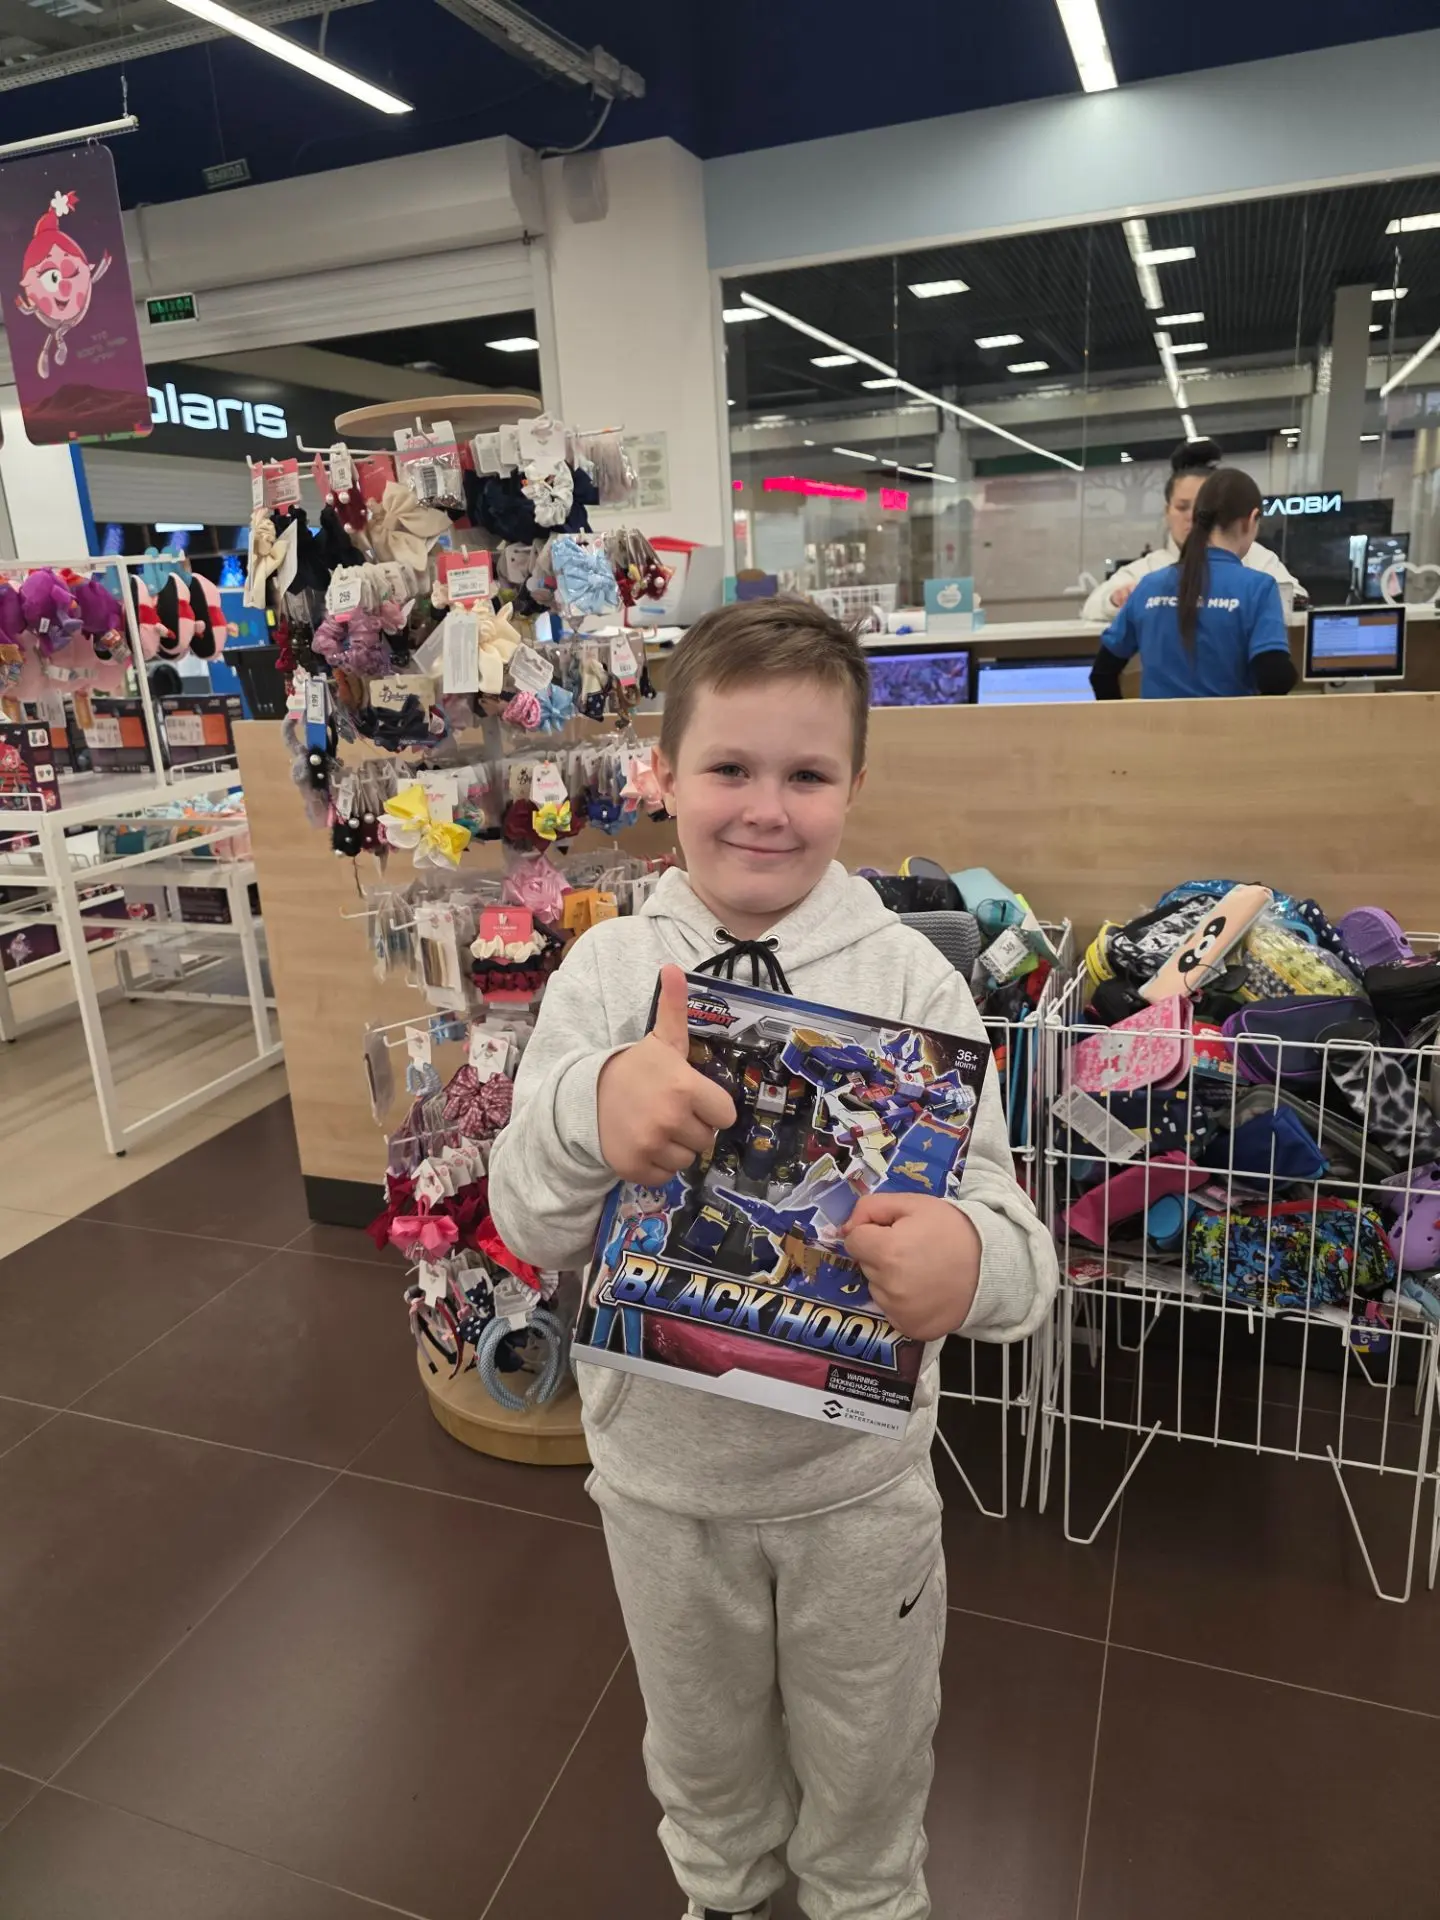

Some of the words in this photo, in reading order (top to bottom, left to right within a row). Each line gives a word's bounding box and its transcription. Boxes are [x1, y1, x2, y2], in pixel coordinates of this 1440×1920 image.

[1145, 595, 1205, 609] детсй
[1207, 598, 1240, 612] мир
[956, 1049, 978, 1062] 36+
[954, 1060, 977, 1071] MONTH
[613, 1254, 777, 1331] BLACK
[768, 1296, 903, 1364] HOOK
[844, 1412, 899, 1430] ENTERTAINMENT
